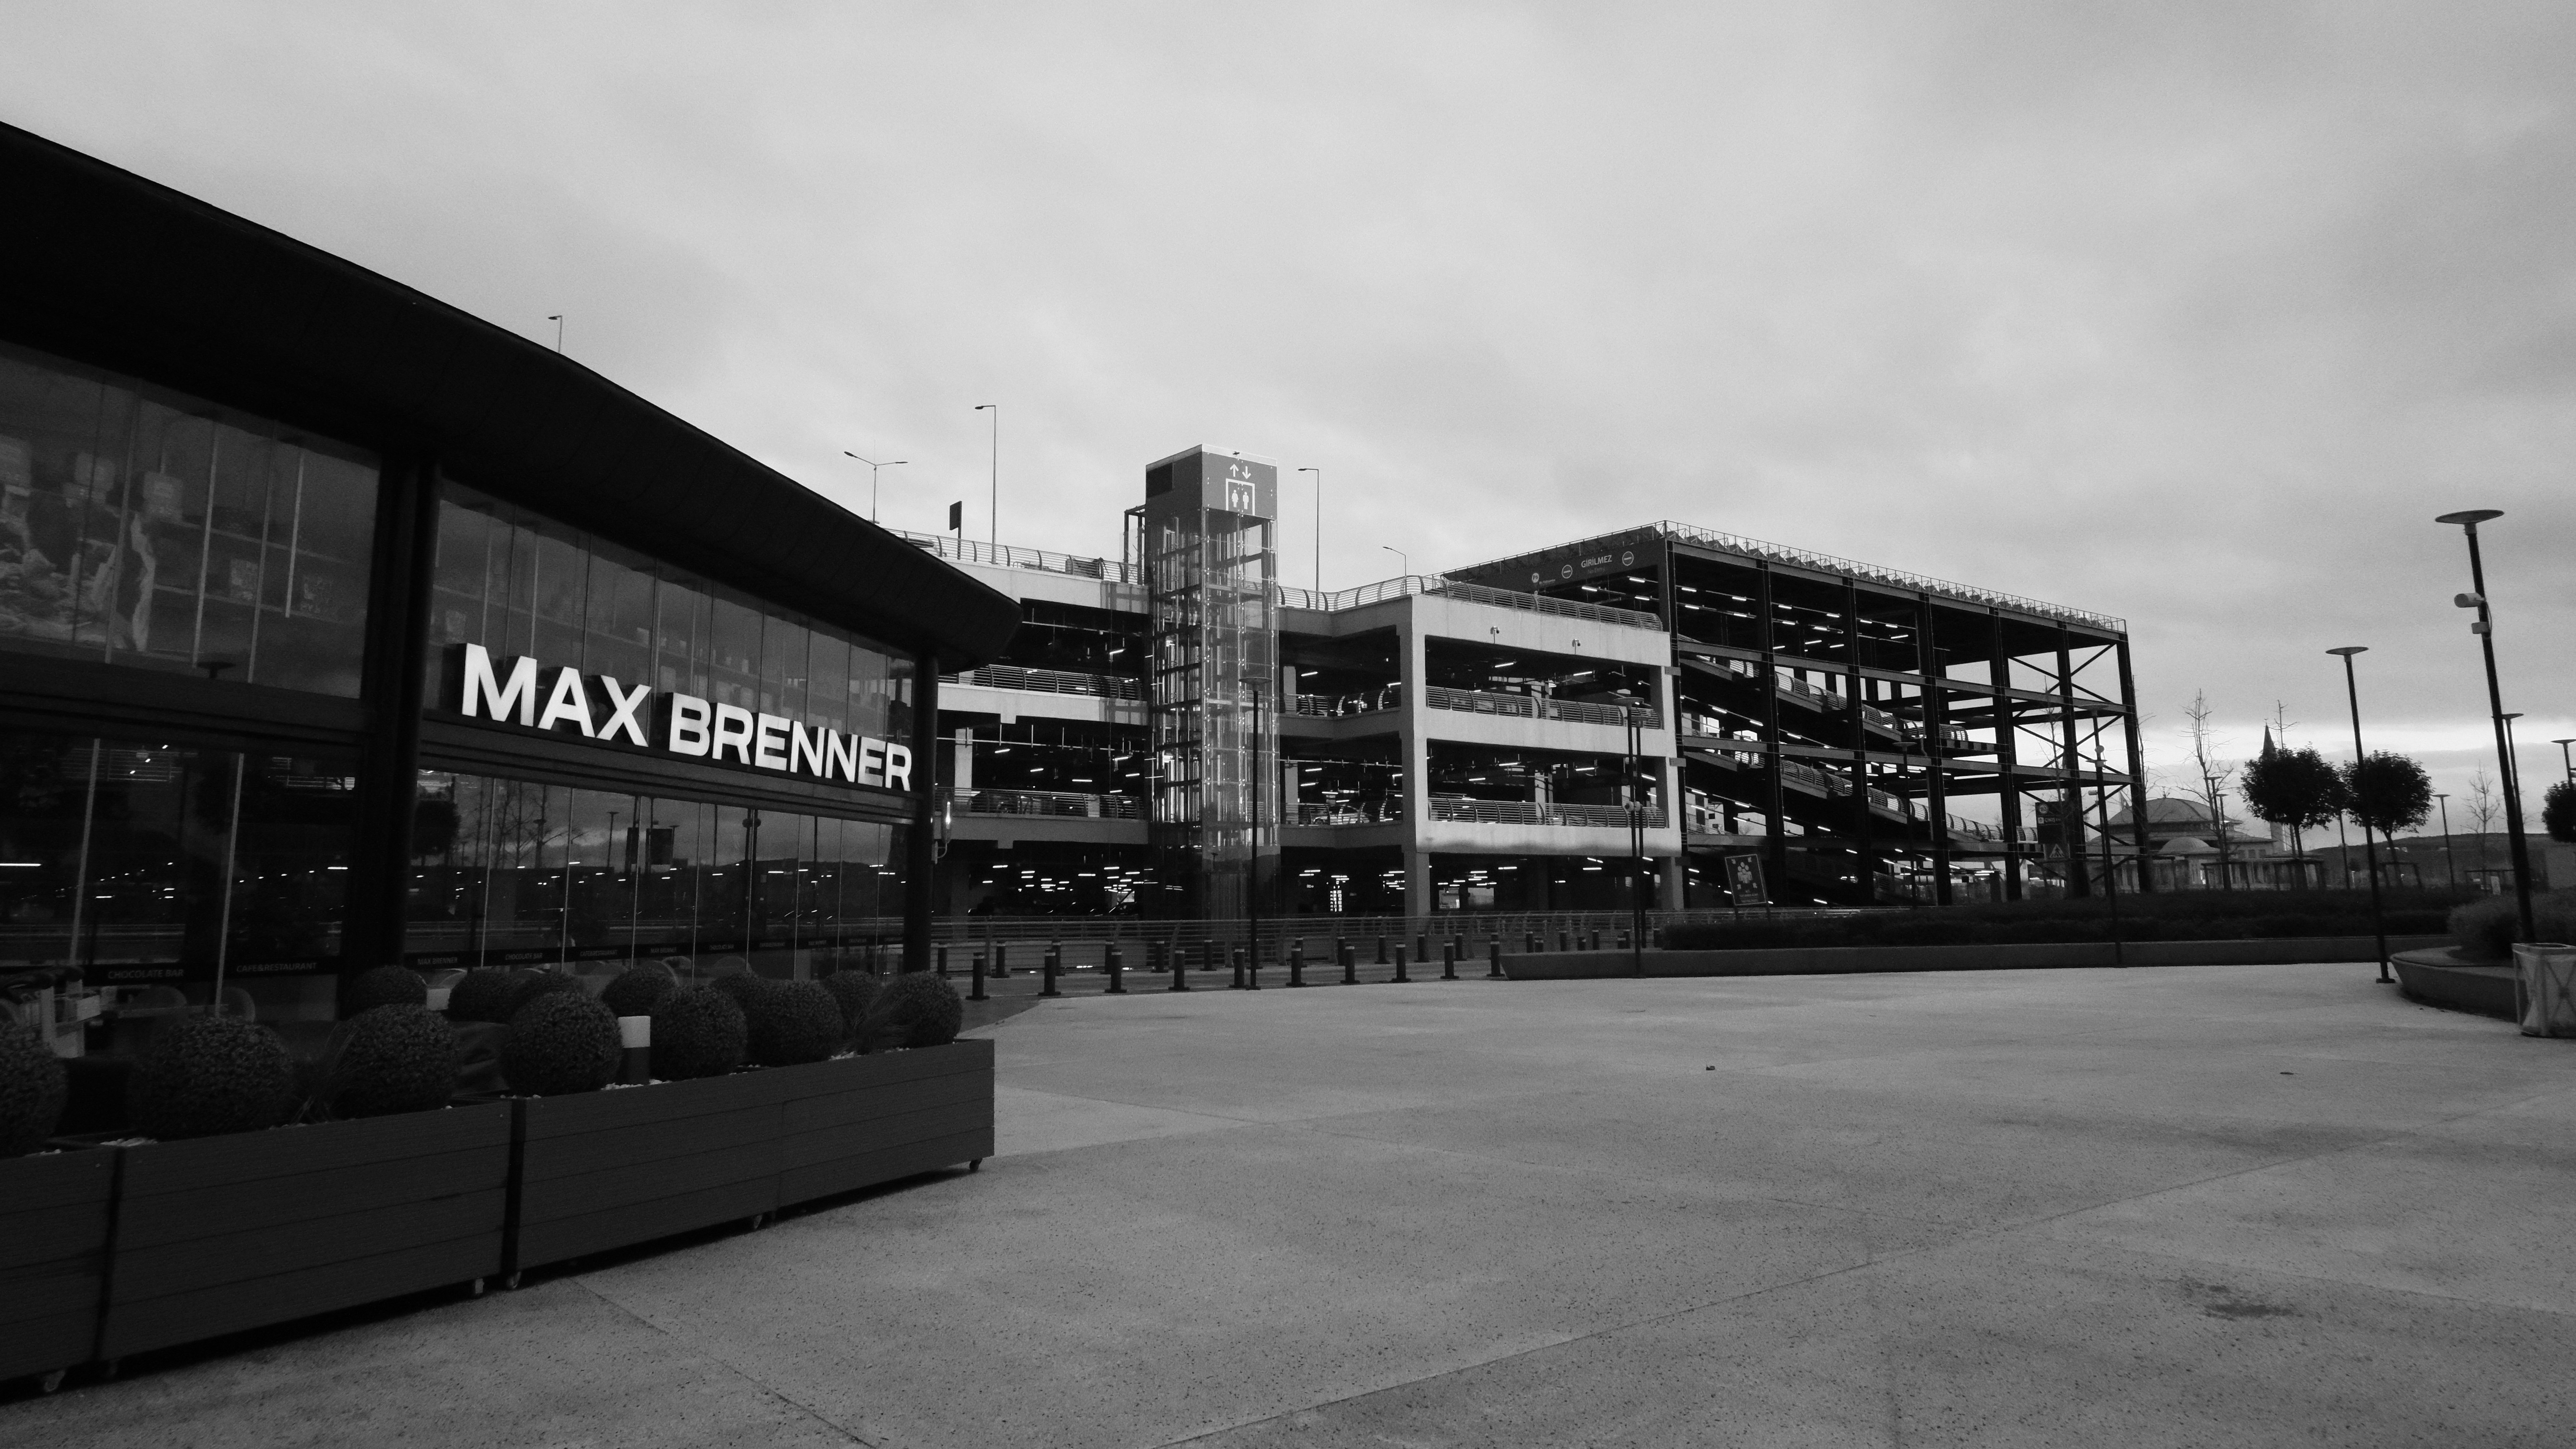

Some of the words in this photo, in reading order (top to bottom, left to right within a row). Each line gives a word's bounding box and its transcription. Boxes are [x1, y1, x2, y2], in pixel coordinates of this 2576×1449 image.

[1581, 555, 1612, 568] GİRİLMEZ
[461, 643, 651, 747] MAX
[669, 692, 911, 791] BRENNER
[236, 962, 317, 973] CAFE&RESTAURANT
[108, 969, 163, 979] CHOCOLATE
[165, 969, 184, 977] BAR
